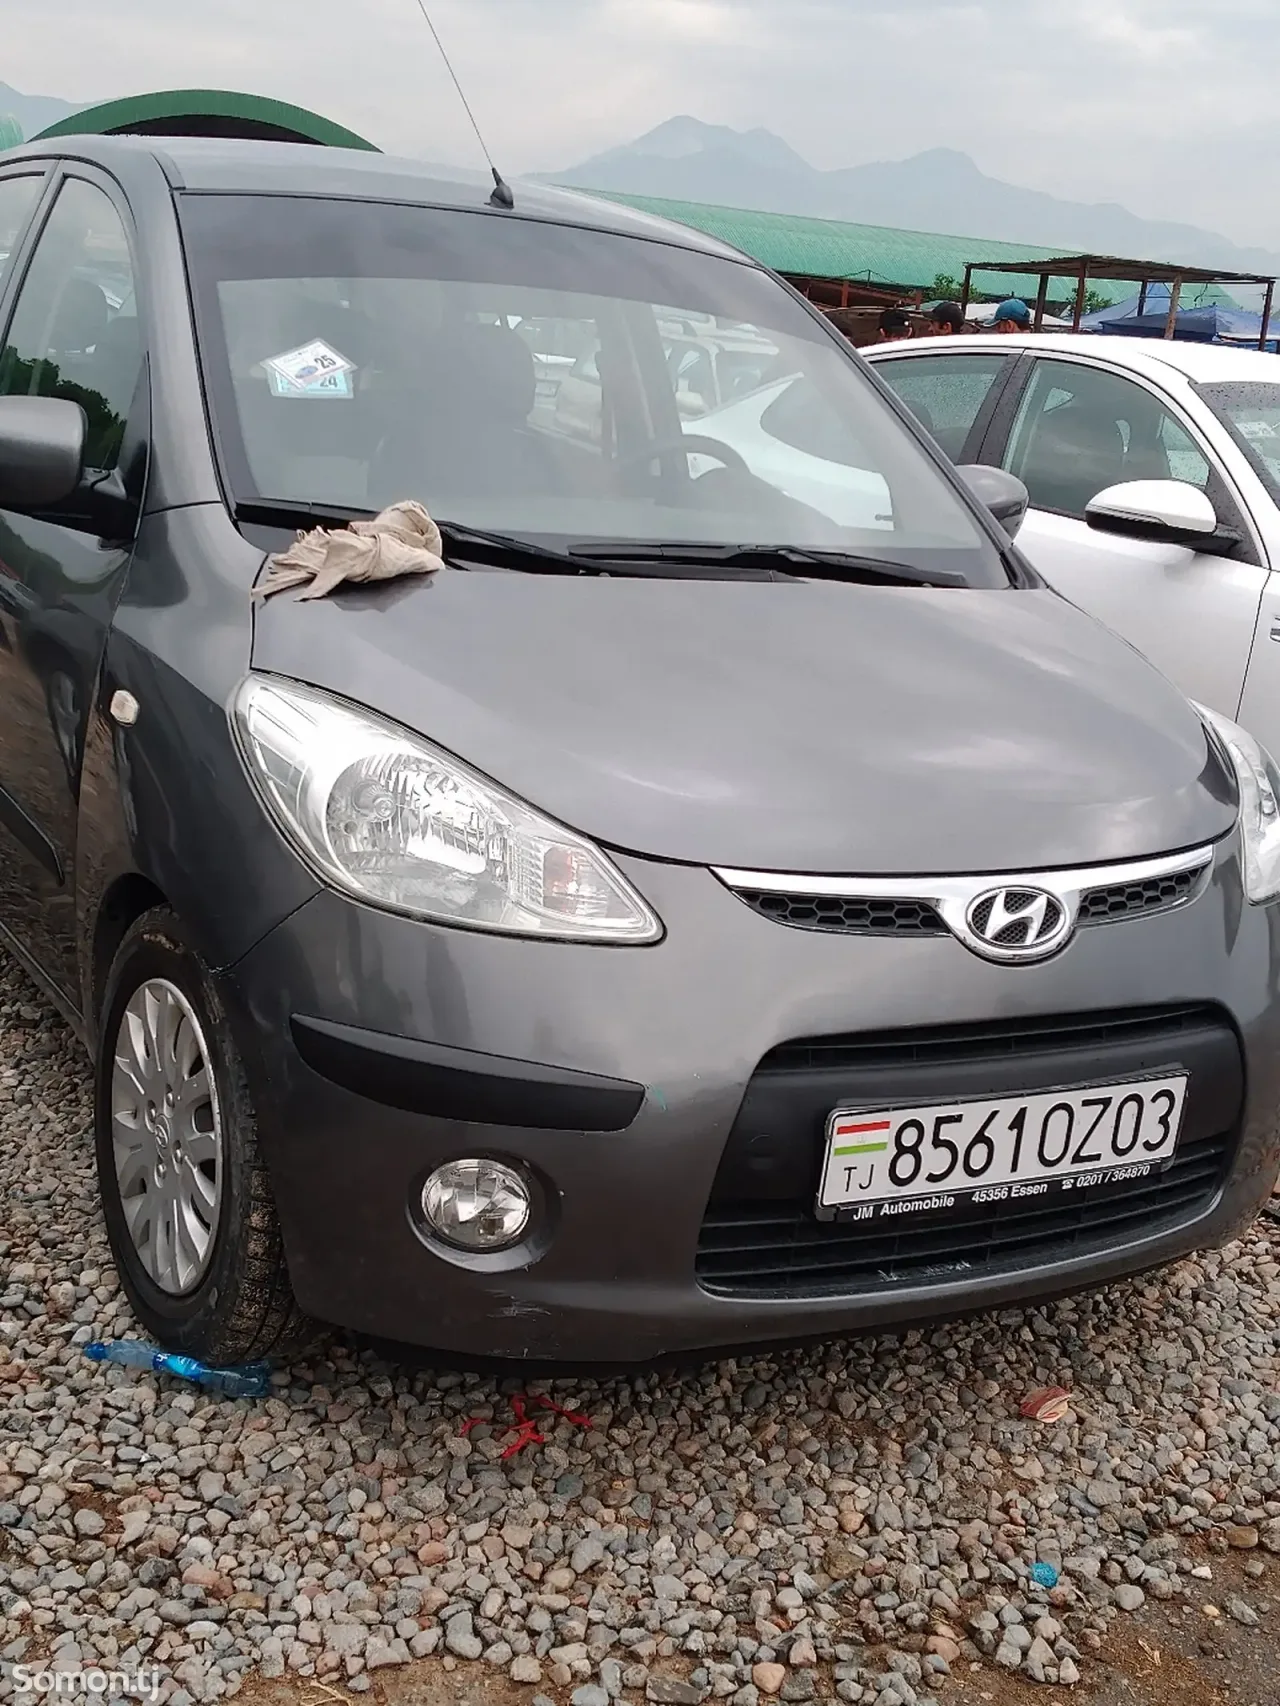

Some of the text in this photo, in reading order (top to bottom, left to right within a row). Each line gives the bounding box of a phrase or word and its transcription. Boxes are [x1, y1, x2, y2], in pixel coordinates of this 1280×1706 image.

[314, 354, 337, 369] 25
[843, 1163, 874, 1193] TJ
[853, 1205, 874, 1221] JM
[880, 1195, 955, 1216] Automobile
[971, 1187, 1008, 1203] 45356
[1011, 1183, 1048, 1198] Essen
